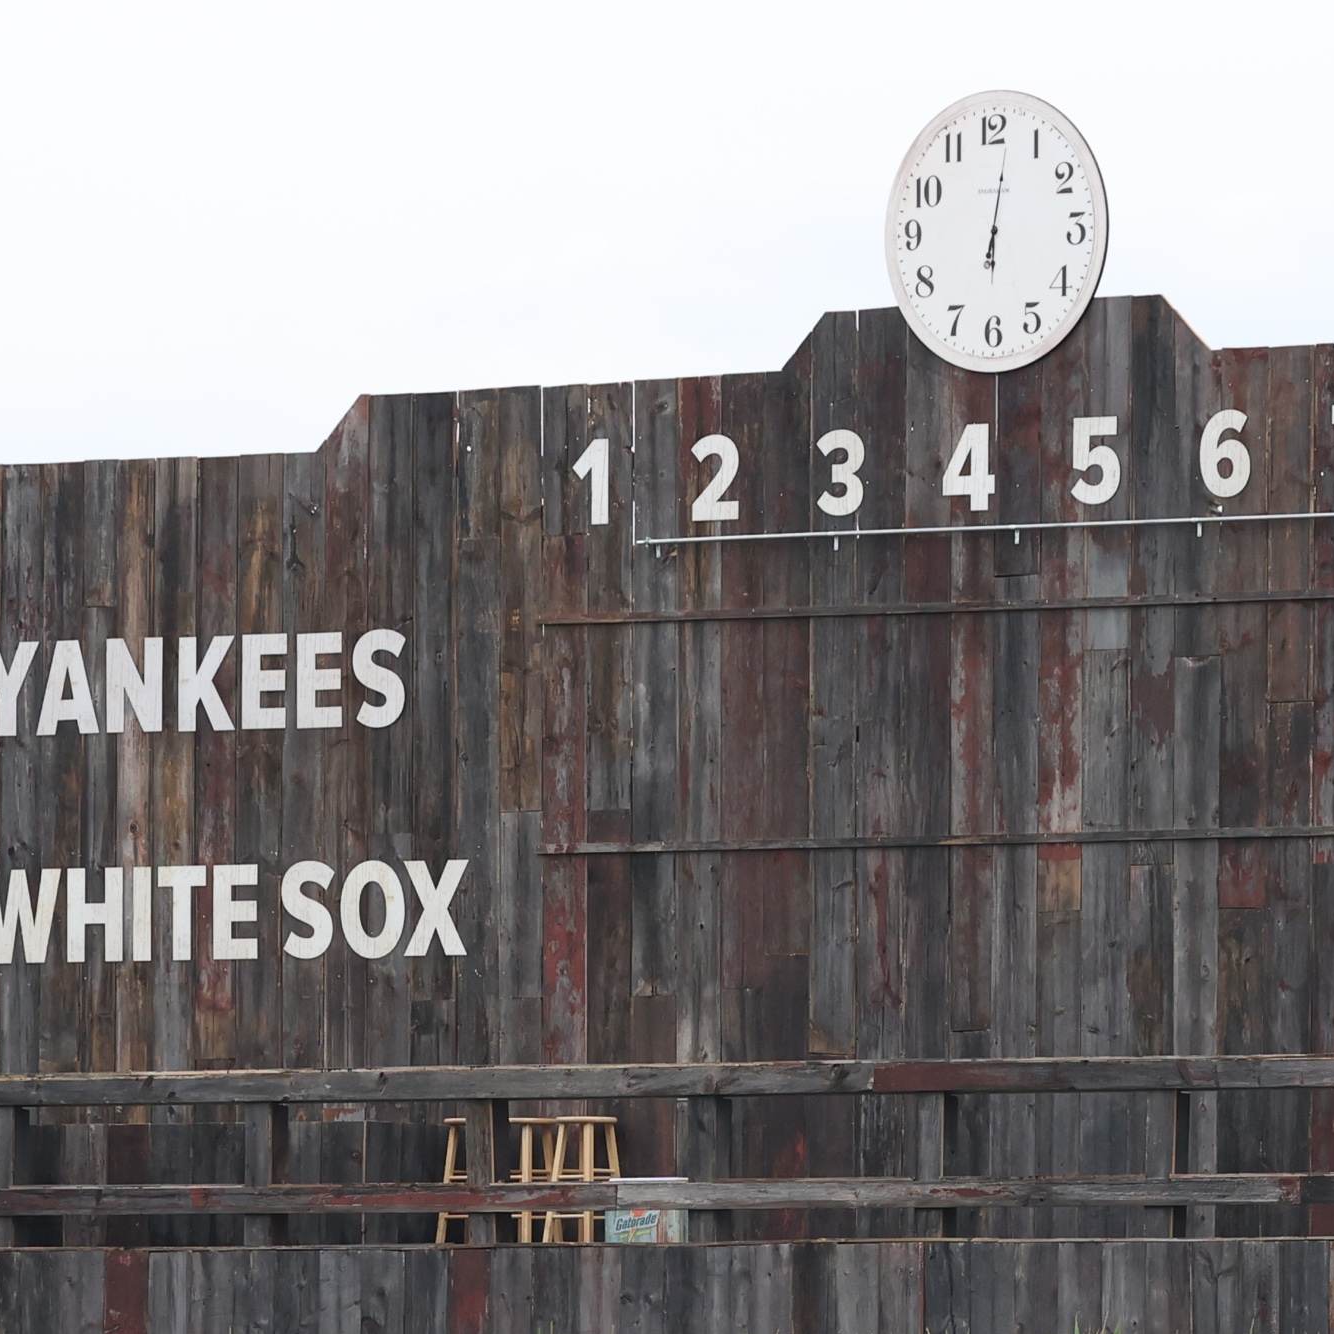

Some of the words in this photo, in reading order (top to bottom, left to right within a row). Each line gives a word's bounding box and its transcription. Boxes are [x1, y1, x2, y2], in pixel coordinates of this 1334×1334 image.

[981, 113, 1007, 146] 12
[1033, 128, 1039, 159] 1
[945, 131, 962, 163] 11
[916, 174, 942, 208] 10
[1054, 161, 1074, 194] 2
[904, 218, 922, 251] 9
[1066, 211, 1086, 245] 3
[915, 264, 934, 298] 8
[1049, 263, 1073, 297] 4
[947, 304, 965, 337] 7
[984, 315, 1003, 348] 6
[1023, 302, 1042, 334] 5
[572, 437, 610, 525] 1
[690, 433, 740, 521] 2
[816, 428, 866, 516] 3
[942, 423, 996, 511] 4
[1070, 415, 1122, 505] 5
[1198, 408, 1251, 498] 6
[280, 859, 470, 960] SOX
[616, 1213, 658, 1232] Gatorade
